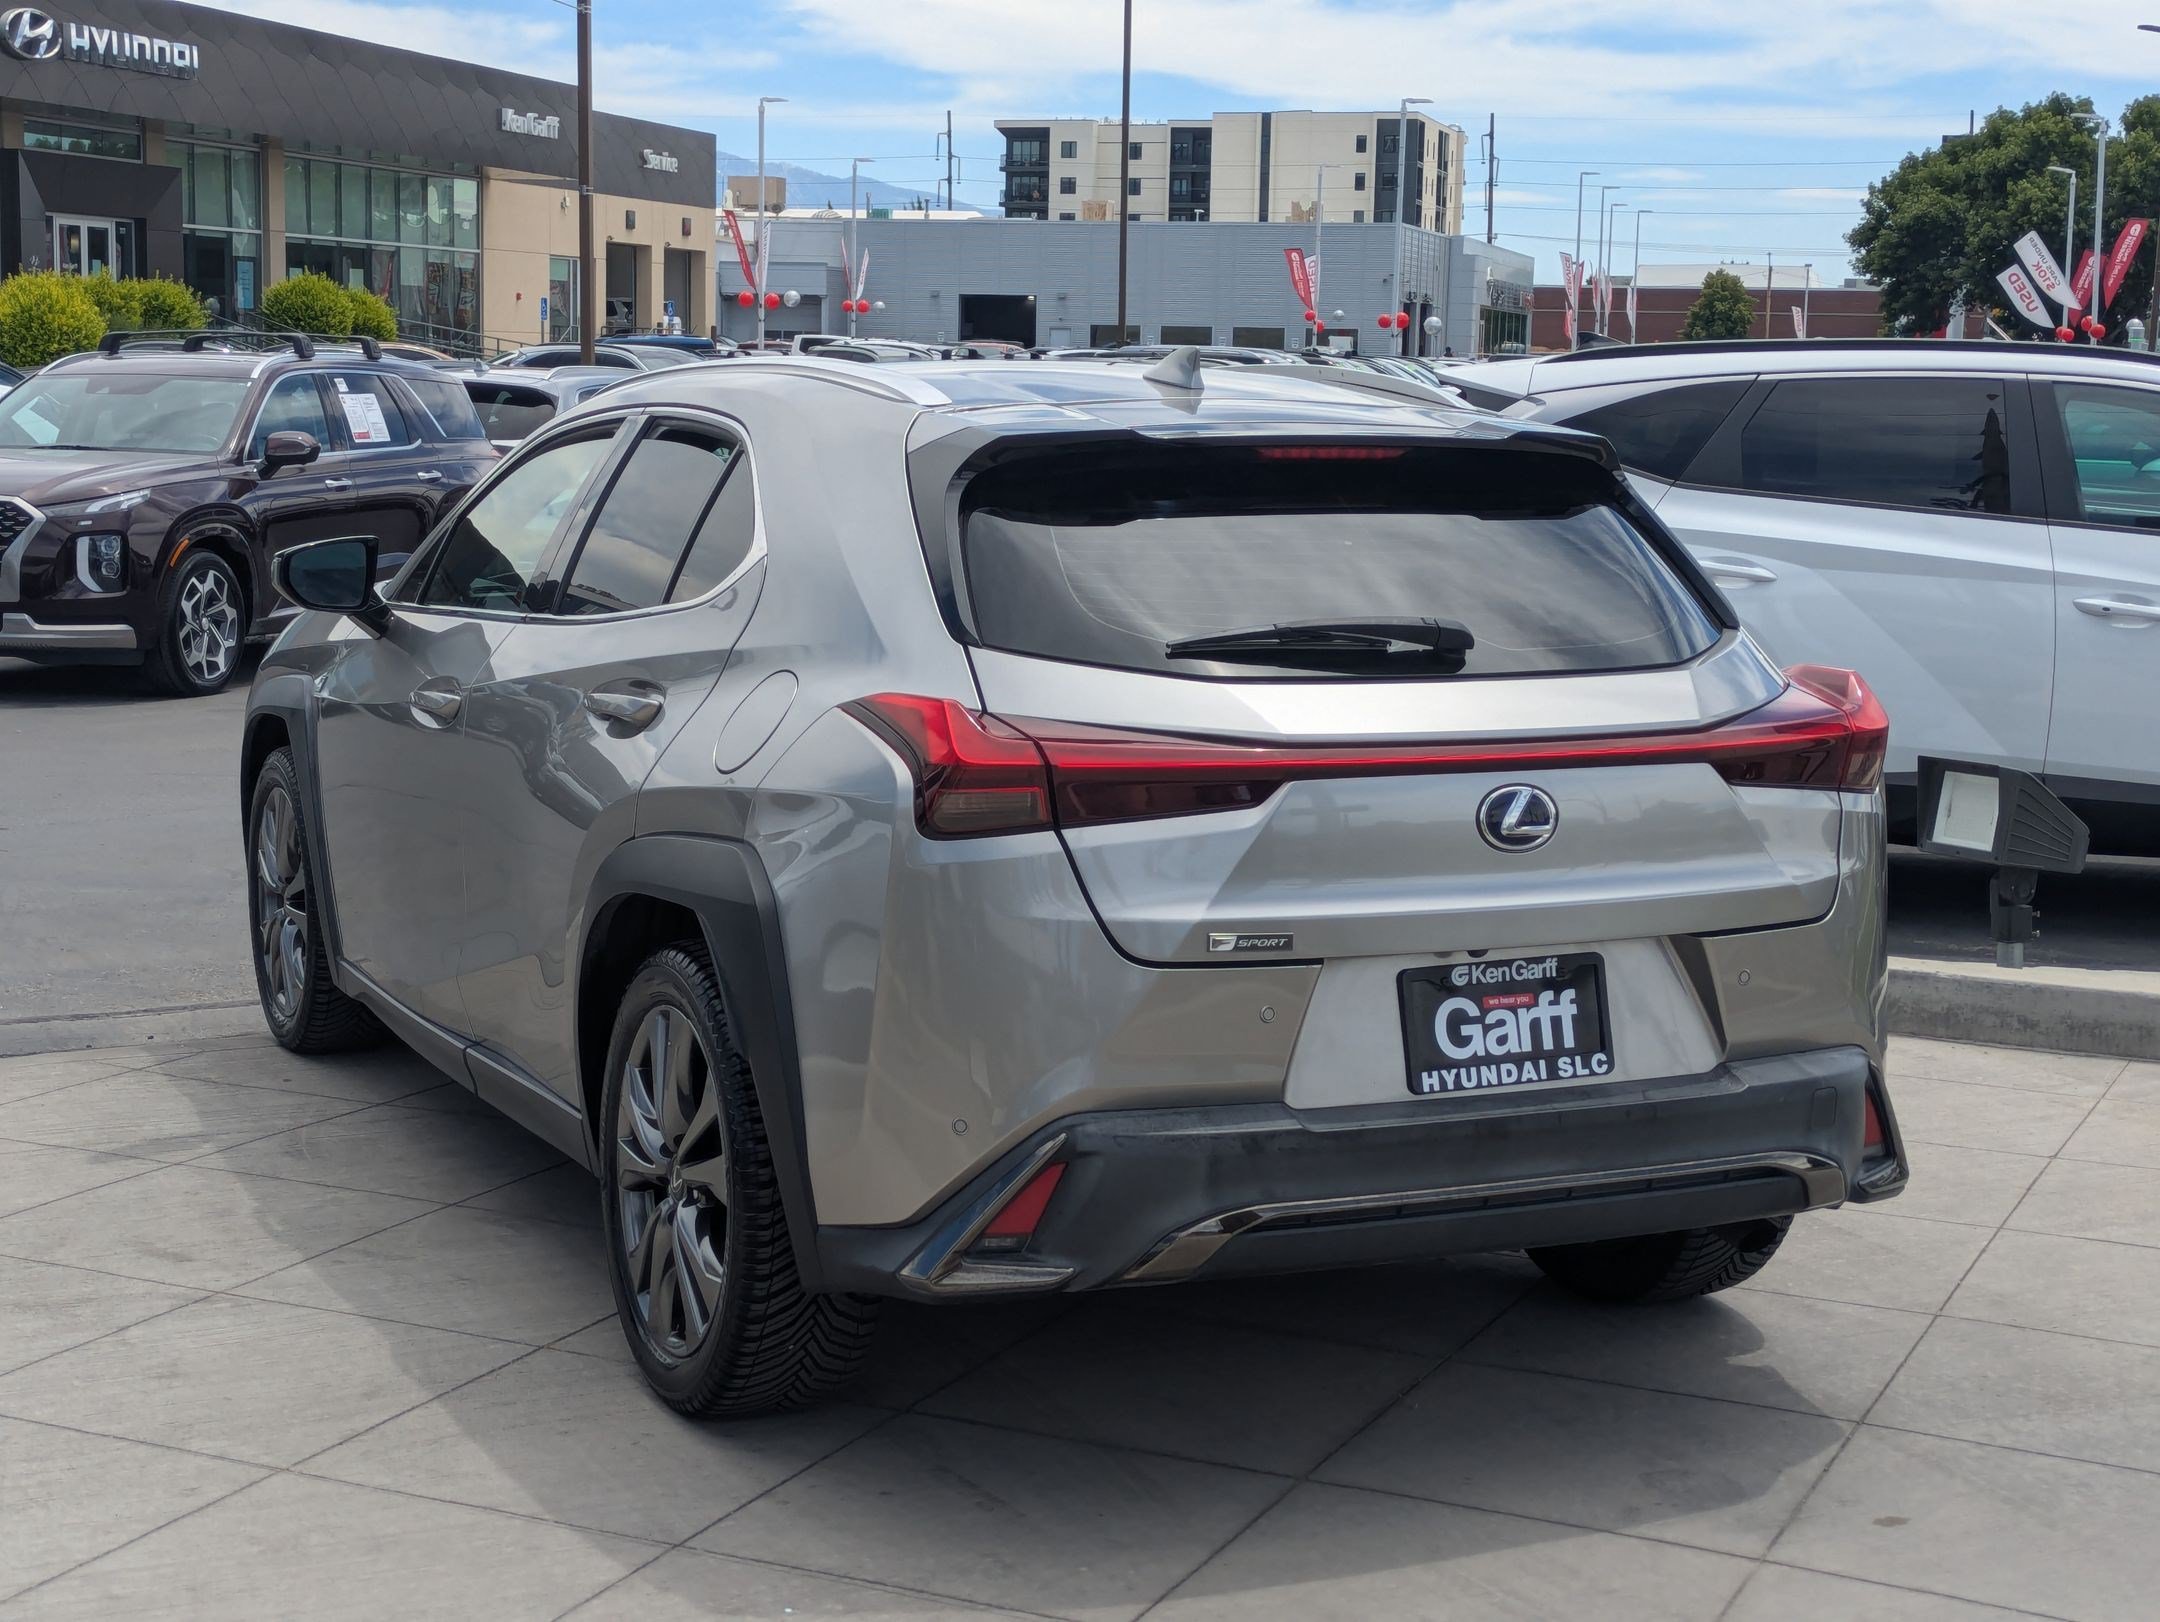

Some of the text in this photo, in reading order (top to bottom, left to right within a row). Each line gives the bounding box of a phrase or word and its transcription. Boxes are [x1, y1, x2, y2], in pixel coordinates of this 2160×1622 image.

[69, 22, 199, 70] HYUNDAI
[501, 107, 560, 140] Ken Garff
[642, 148, 678, 174] Service
[1237, 938, 1288, 947] SPORT
[1471, 957, 1558, 985] Ken Garff
[1499, 996, 1515, 1004] hear
[1516, 996, 1529, 1005] you
[1434, 988, 1577, 1060] Garff
[1421, 1052, 1609, 1093] HYUNDAI SLC
